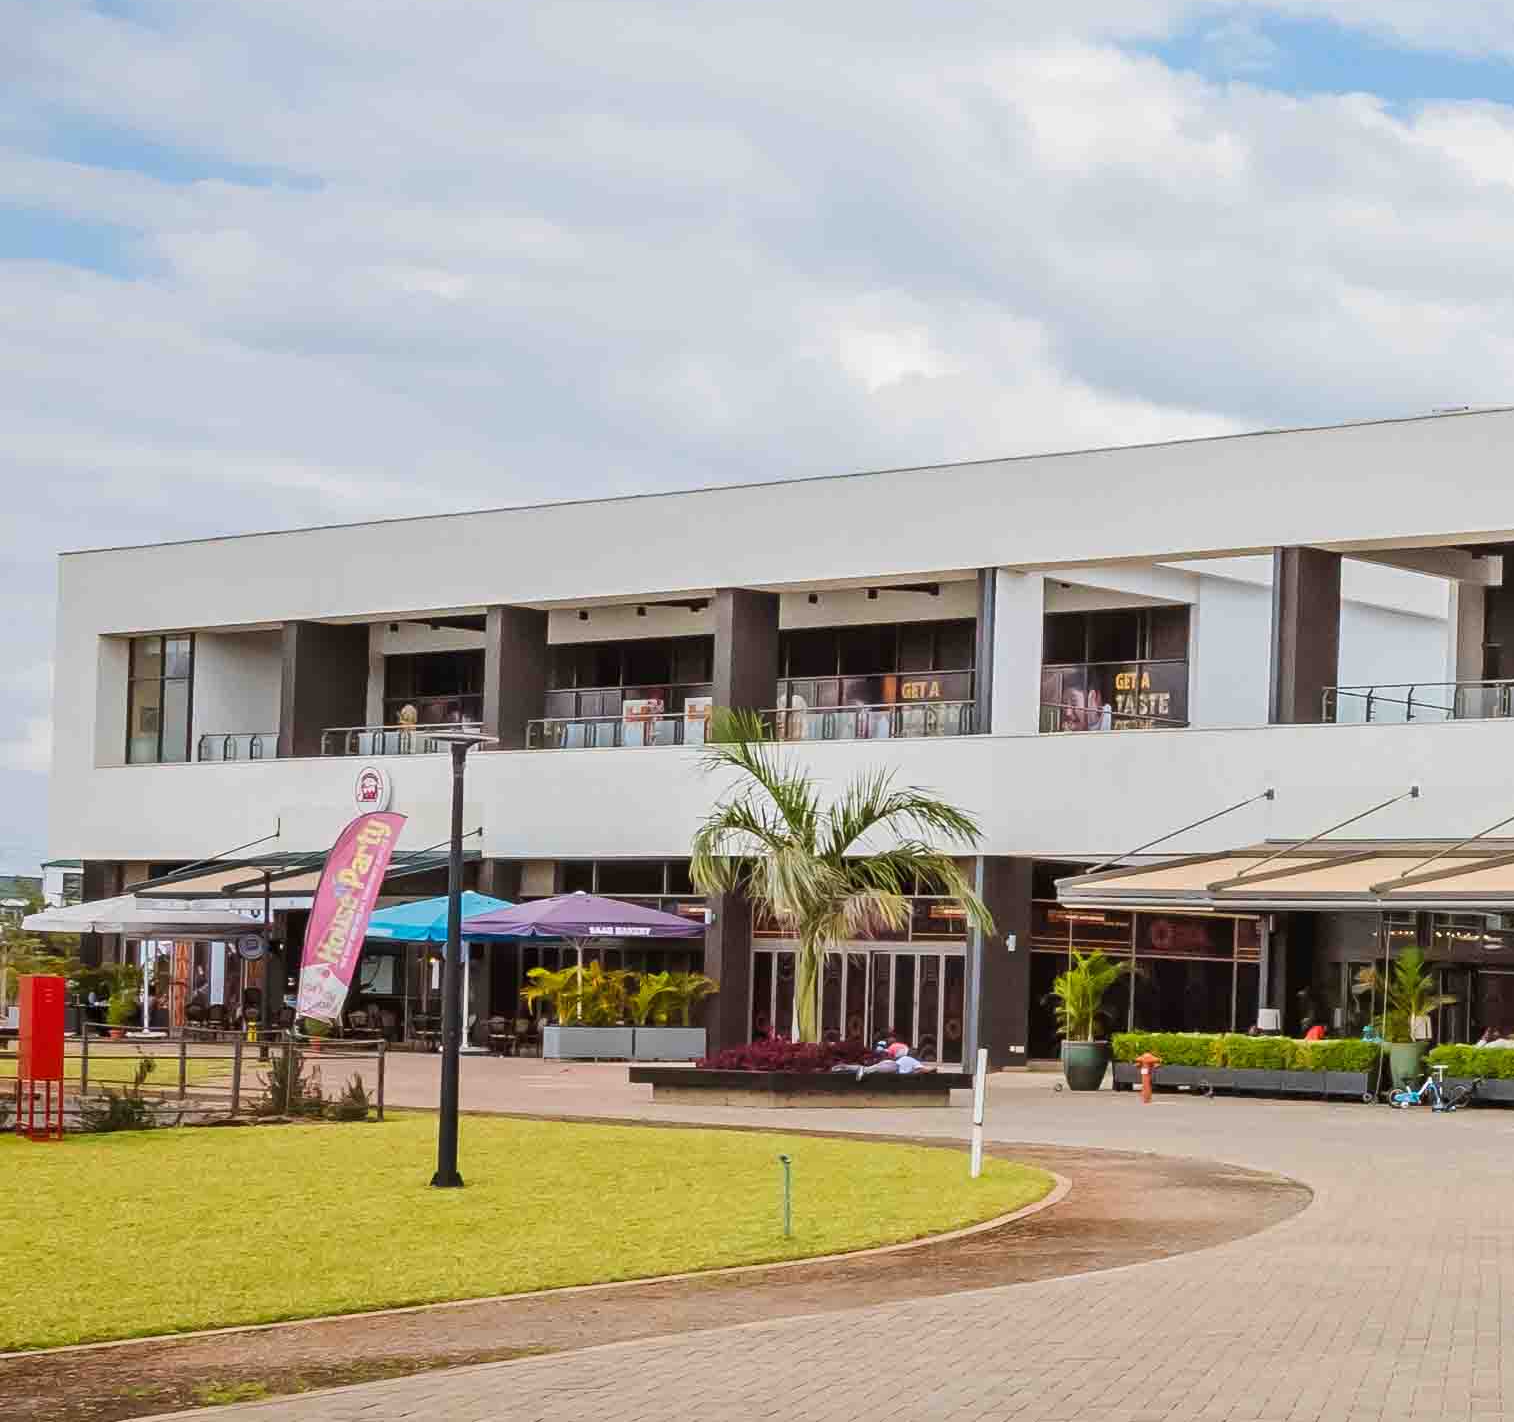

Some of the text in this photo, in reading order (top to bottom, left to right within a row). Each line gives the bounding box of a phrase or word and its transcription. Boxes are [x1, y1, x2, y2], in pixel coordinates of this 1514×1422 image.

[902, 681, 942, 699] GET A
[1115, 672, 1151, 691] GET A
[1115, 692, 1170, 715] TASTE
[336, 818, 394, 890] Party
